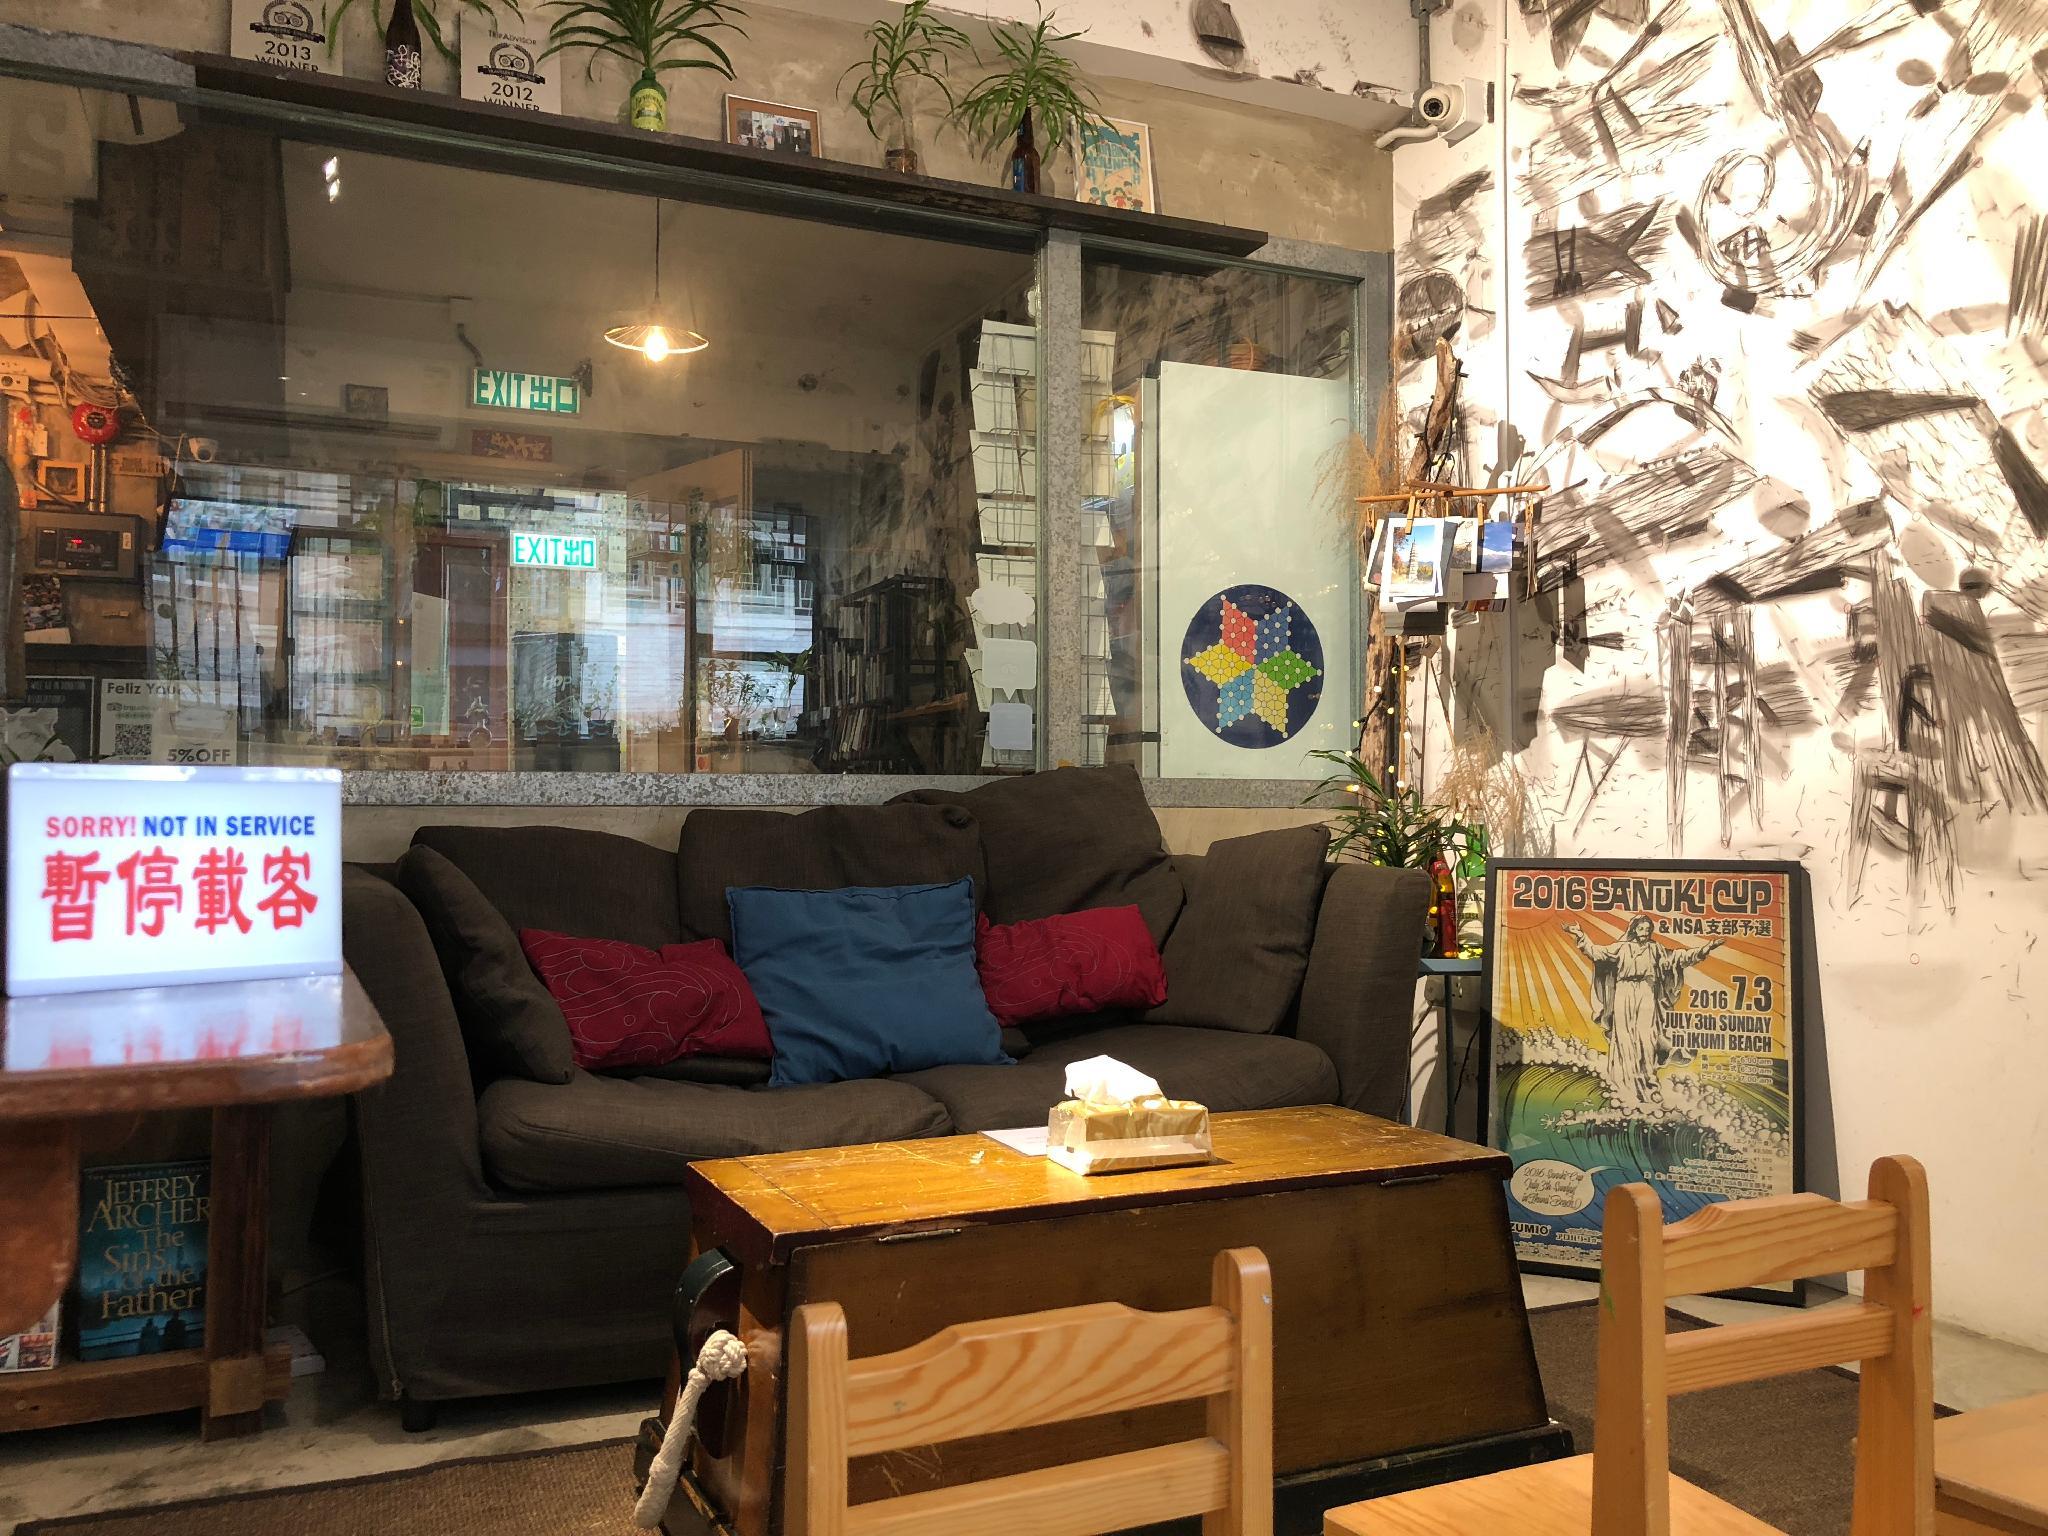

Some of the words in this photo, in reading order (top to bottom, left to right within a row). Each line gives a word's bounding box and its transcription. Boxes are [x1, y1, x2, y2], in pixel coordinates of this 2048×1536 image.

[264, 41, 311, 60] 2013
[491, 81, 533, 101] 2012
[476, 369, 525, 408] EXIT
[529, 376, 578, 413] 出口
[515, 536, 562, 565] EXIT
[563, 539, 595, 567] 出口
[107, 682, 141, 695] Feliz
[167, 748, 231, 763] 5%OFF
[46, 815, 137, 838] SORRY!
[143, 815, 187, 837] NOT
[196, 815, 218, 837] IN
[225, 815, 315, 836] SERVICE
[41, 845, 318, 942] 暫停載客
[1514, 876, 1586, 909] 2016
[1592, 877, 1704, 914] SANUKI
[1713, 879, 1772, 914] CUP
[1659, 921, 1670, 933] &
[1672, 919, 1704, 934] NSA
[1705, 920, 1772, 937] 支部予選
[1689, 989, 1728, 1010] 2016
[1731, 975, 1773, 1012] 7.3
[1665, 1011, 1692, 1030] JULY
[1694, 1013, 1717, 1031] 3th
[1719, 1015, 1772, 1033] SUNDAY
[1672, 1031, 1685, 1048] in
[1687, 1032, 1725, 1050] IKUMI
[1728, 1035, 1772, 1053] BEACH
[105, 1174, 201, 1208] JEFFREY
[87, 1197, 210, 1232] ARCHER
[136, 1226, 185, 1248] The
[104, 1244, 167, 1274] Sins
[156, 1263, 194, 1287] the
[101, 1280, 203, 1319] Father
